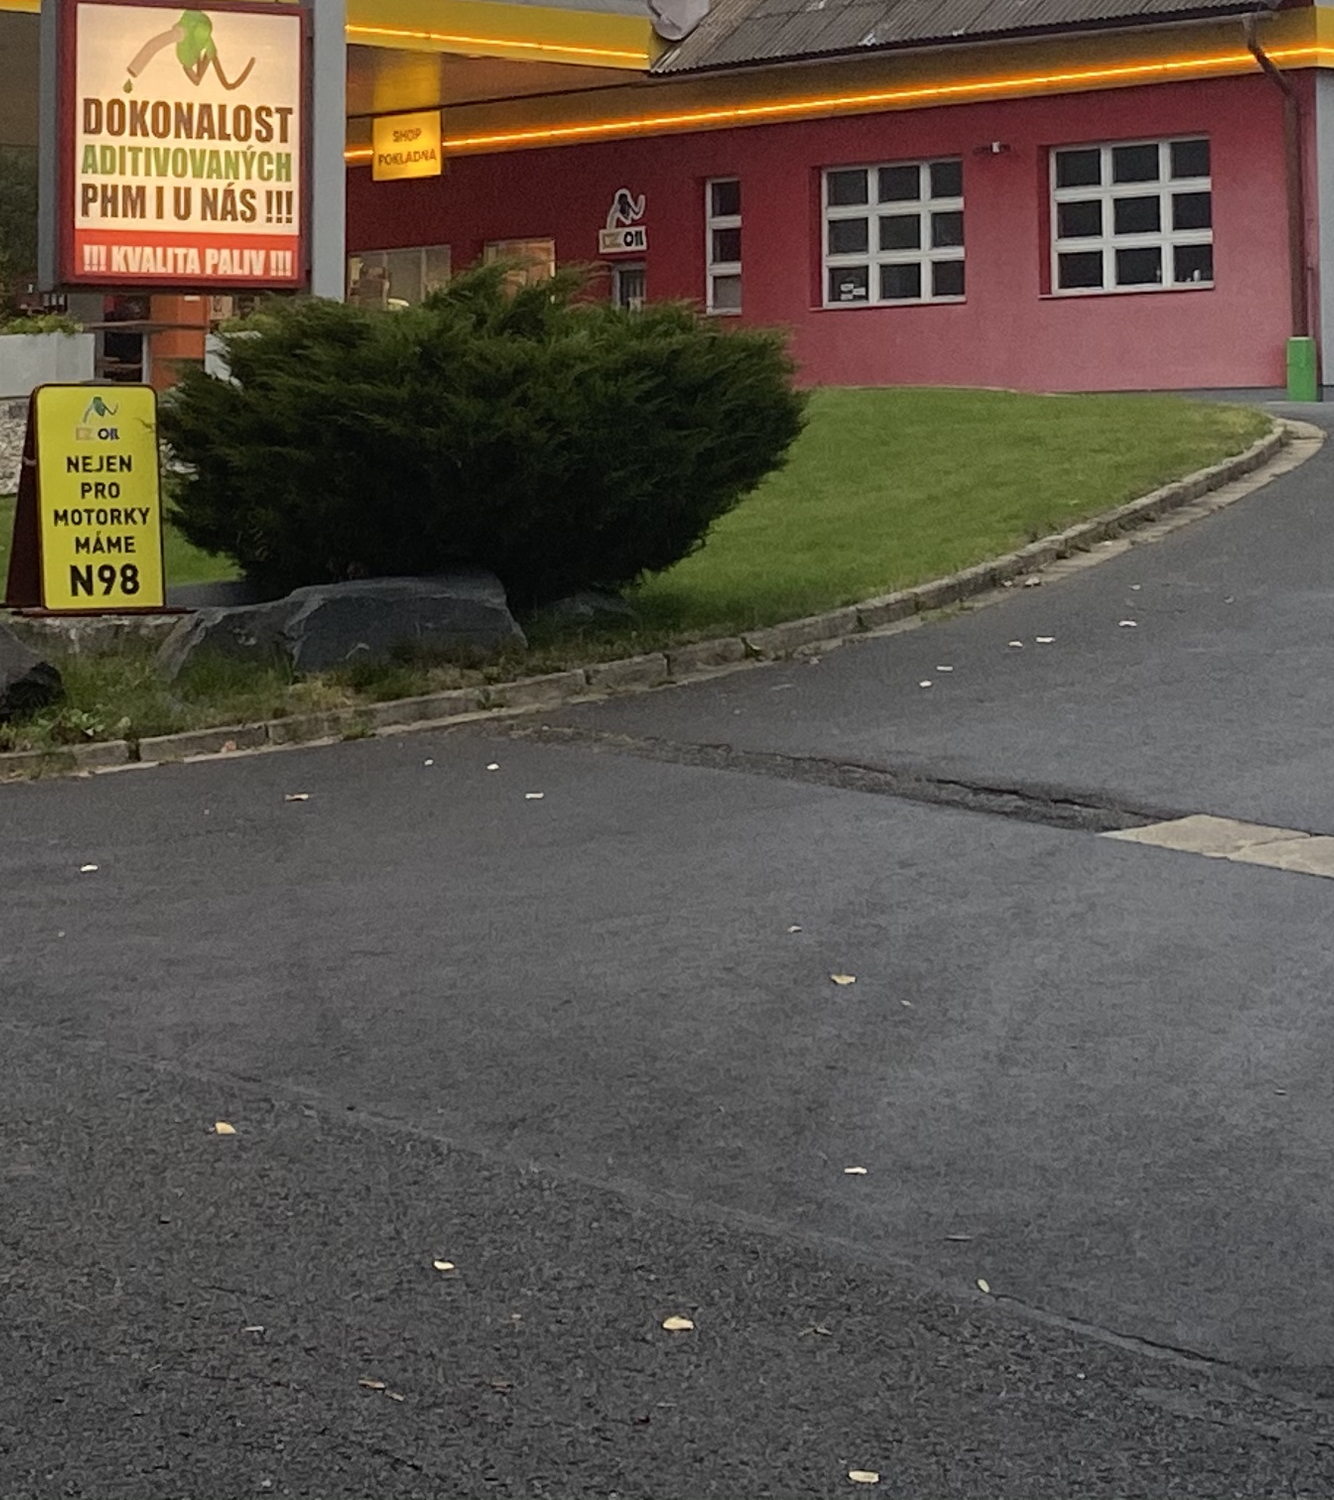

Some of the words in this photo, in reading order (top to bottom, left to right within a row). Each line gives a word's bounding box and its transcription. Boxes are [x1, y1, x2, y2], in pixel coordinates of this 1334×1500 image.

[82, 98, 293, 143] DOKONALOST
[392, 128, 422, 142] SHOP
[81, 144, 292, 182] ADITIVOVANÝCH
[378, 148, 437, 166] POKLADNA
[81, 183, 146, 219] PHM
[156, 186, 164, 219] I
[173, 186, 192, 221] U
[201, 182, 257, 223] NÁS
[112, 245, 201, 275] KVALITA
[205, 249, 265, 276] PALIV
[66, 455, 132, 473] NEJEN
[81, 482, 121, 500] PRO
[54, 507, 151, 527] MOTORKY
[75, 531, 136, 554] MÁME
[70, 563, 140, 597] N98
